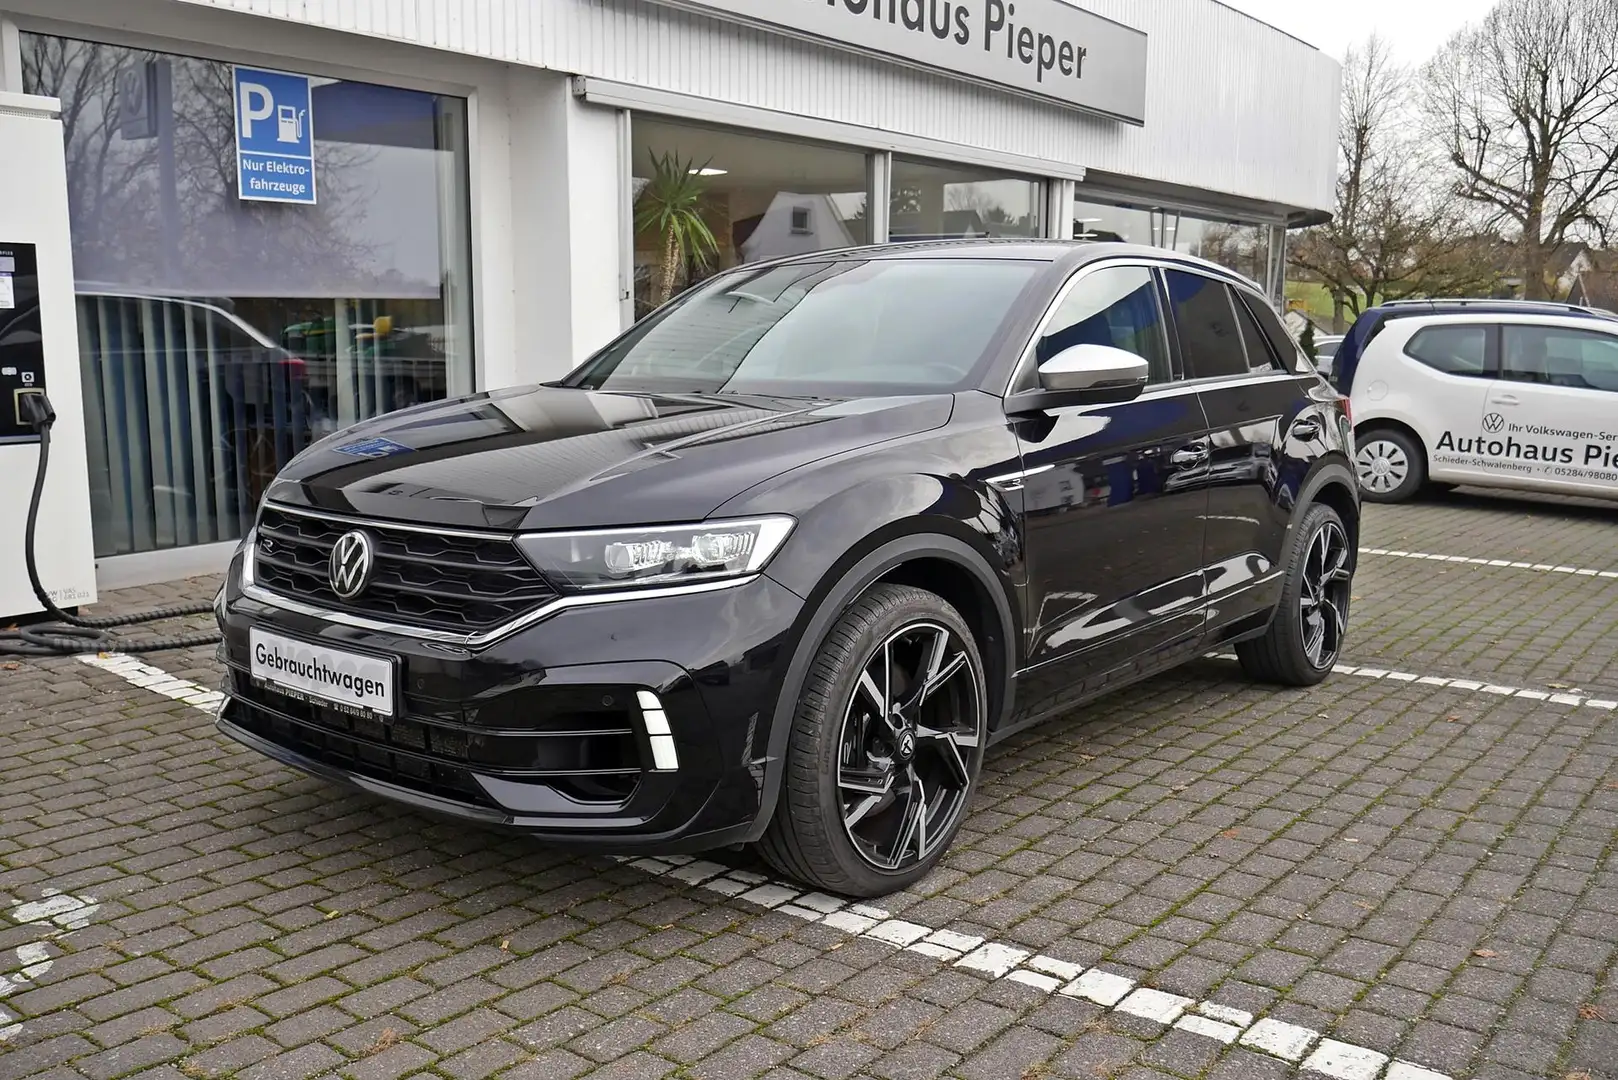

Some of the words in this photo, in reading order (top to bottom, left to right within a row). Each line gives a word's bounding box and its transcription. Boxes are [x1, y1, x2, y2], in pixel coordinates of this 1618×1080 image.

[984, 0, 1087, 83] Pieper
[239, 81, 274, 139] P
[242, 159, 265, 172] Nur
[266, 161, 310, 175] Elektro-
[250, 177, 306, 195] fahrzeuge
[1508, 423, 1523, 433] Ihr
[1435, 430, 1574, 464] Autohaus
[1433, 454, 1533, 474] Schieder-Schwalenberg
[1554, 467, 1618, 482] 05284/98080
[255, 642, 385, 698] Gebrauchtwagen
